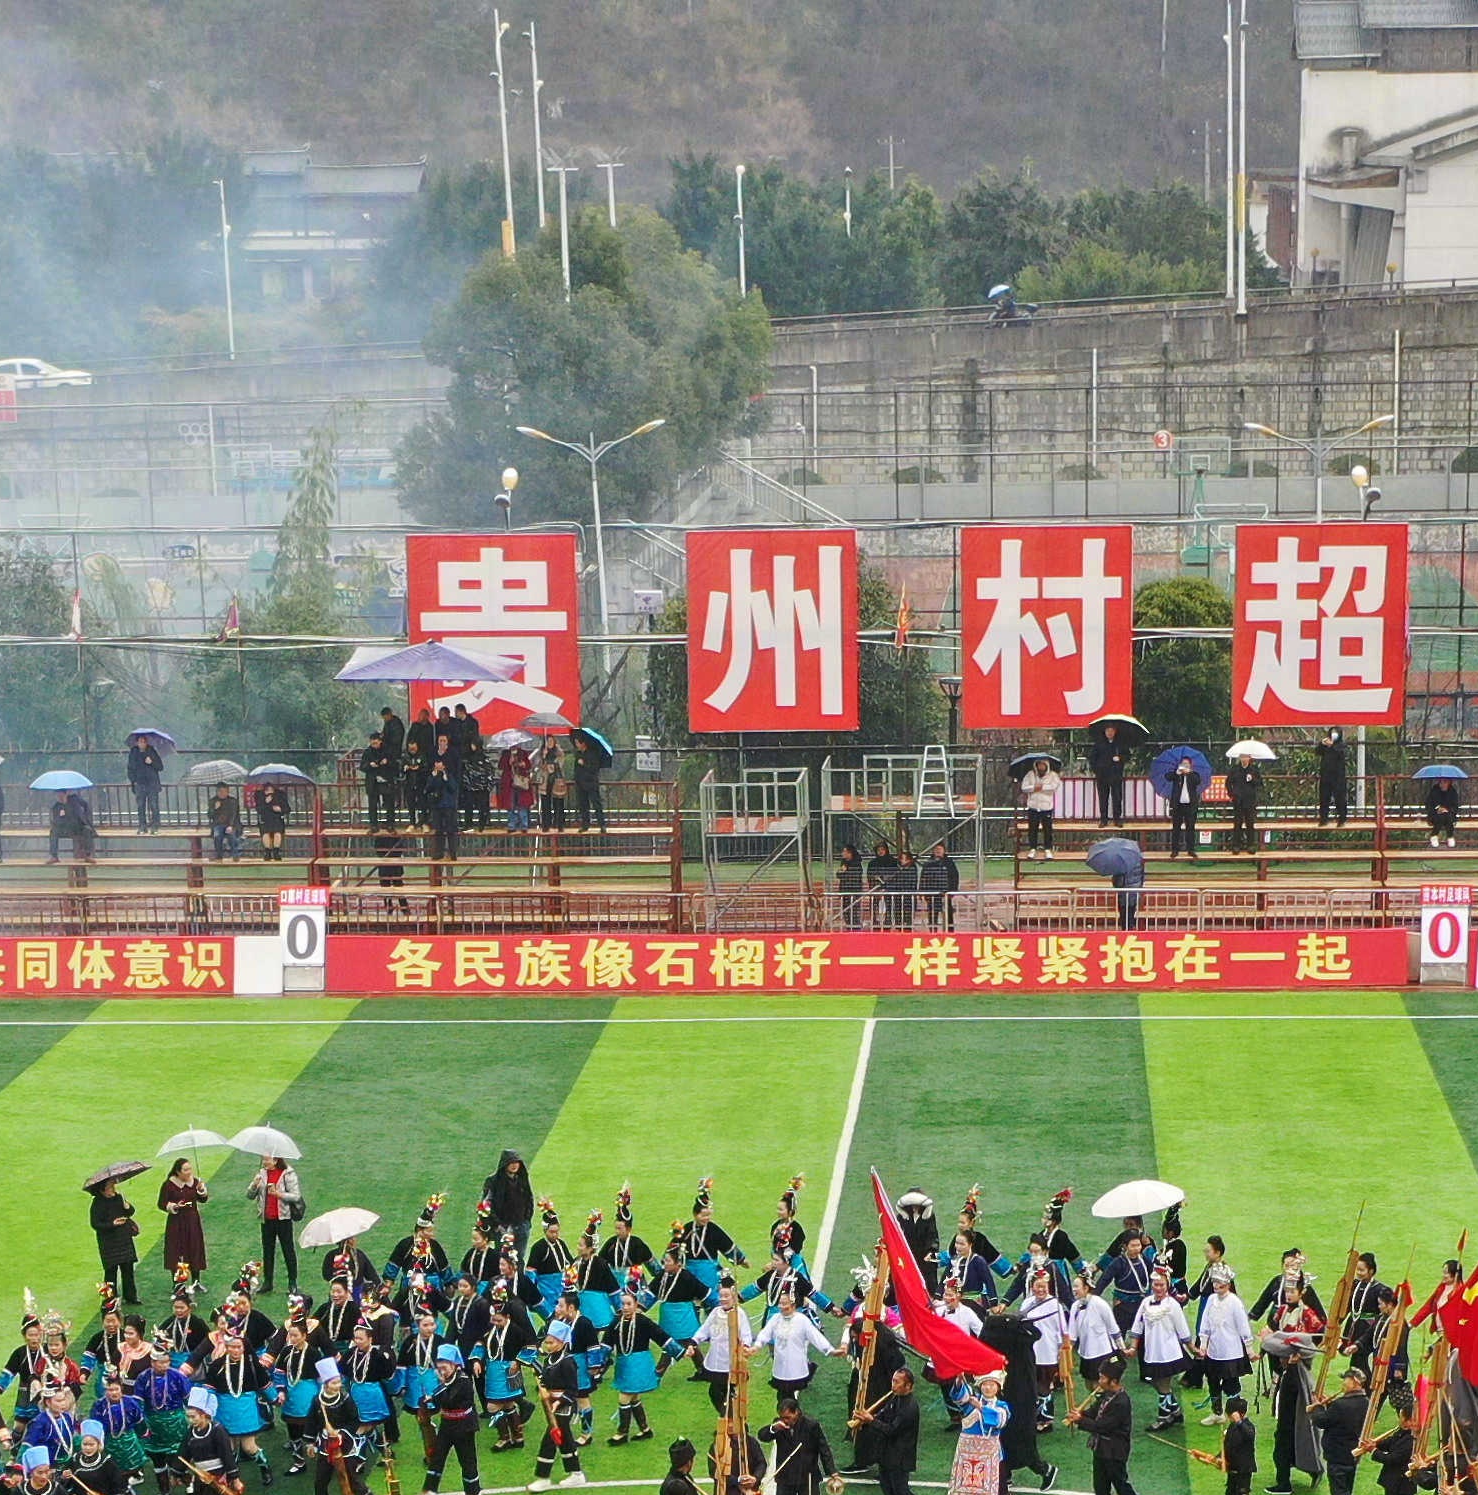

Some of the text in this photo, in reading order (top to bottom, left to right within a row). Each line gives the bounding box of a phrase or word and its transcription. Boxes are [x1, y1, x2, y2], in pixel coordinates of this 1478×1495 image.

[1157, 431, 1169, 447] 3
[287, 914, 317, 960] 0
[1429, 912, 1460, 958] 0
[387, 934, 1353, 988] 各民族像石榴籽一样紧紧抱在一起
